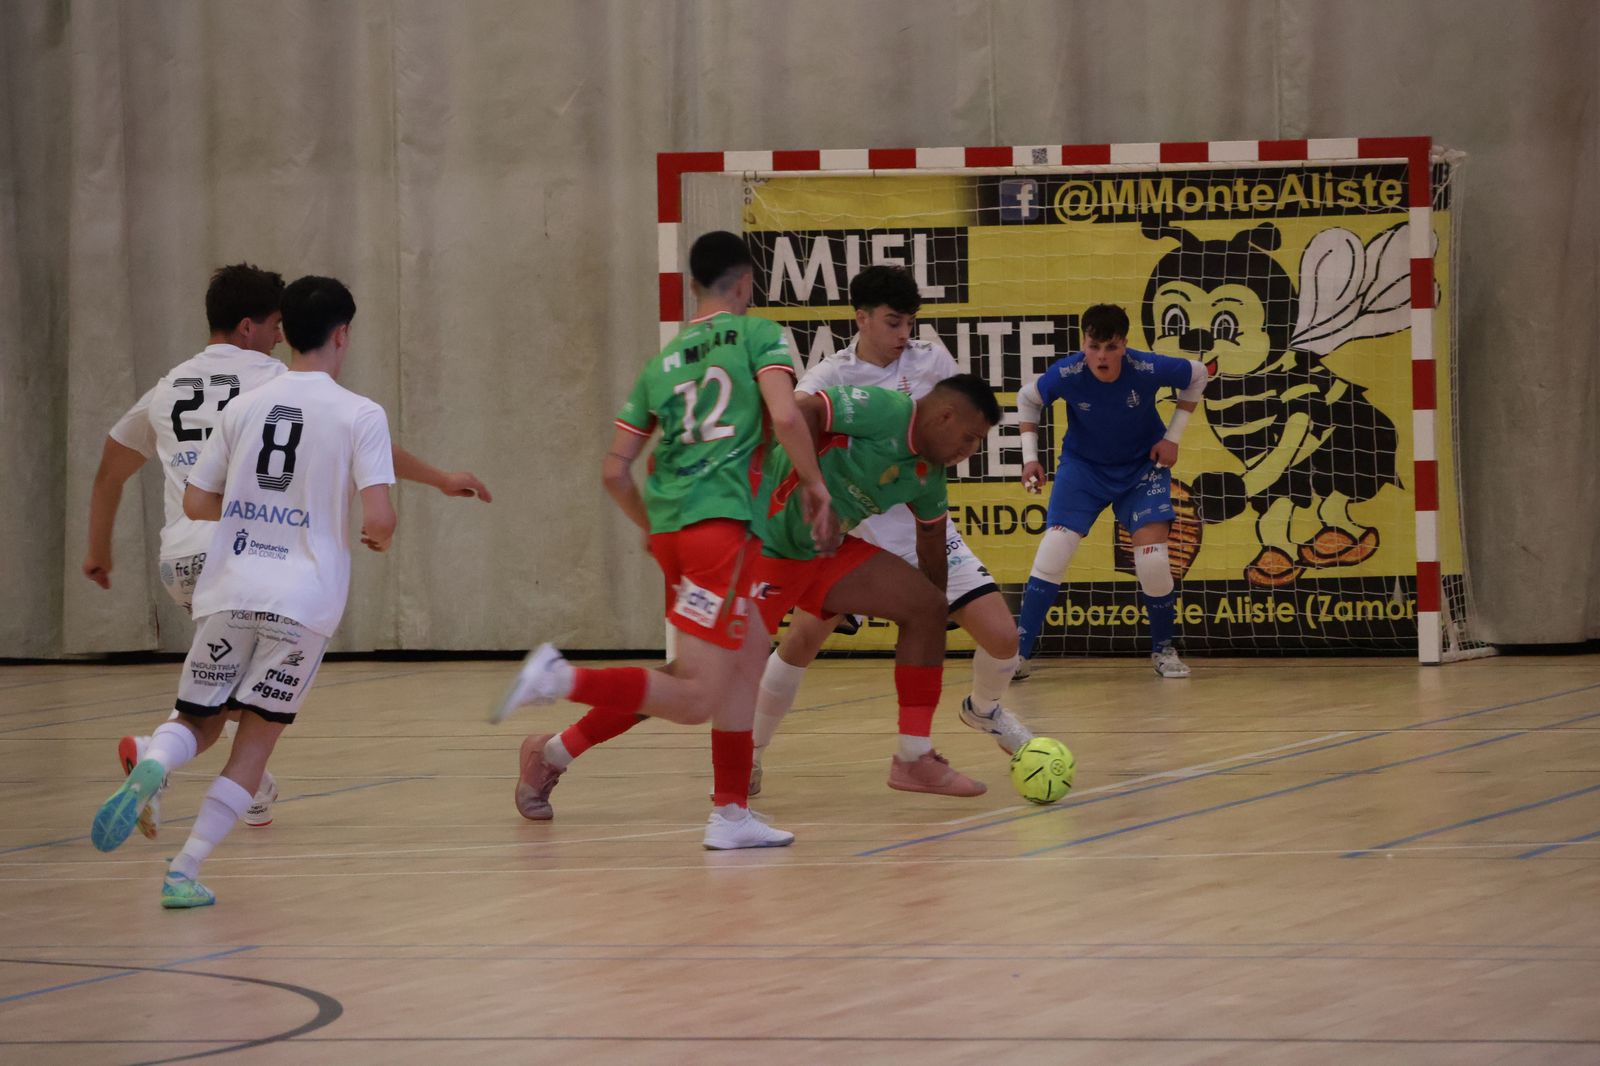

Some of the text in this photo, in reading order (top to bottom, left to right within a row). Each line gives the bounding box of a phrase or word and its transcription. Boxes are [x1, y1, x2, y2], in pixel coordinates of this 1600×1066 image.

[1054, 171, 1404, 225] @MMonteAliste
[769, 233, 945, 301] MIEL
[673, 365, 735, 444] 12
[256, 404, 303, 492] 8
[229, 500, 309, 528] ABANCA
[250, 540, 289, 553] Deputación
[1214, 596, 1295, 624] Aliste
